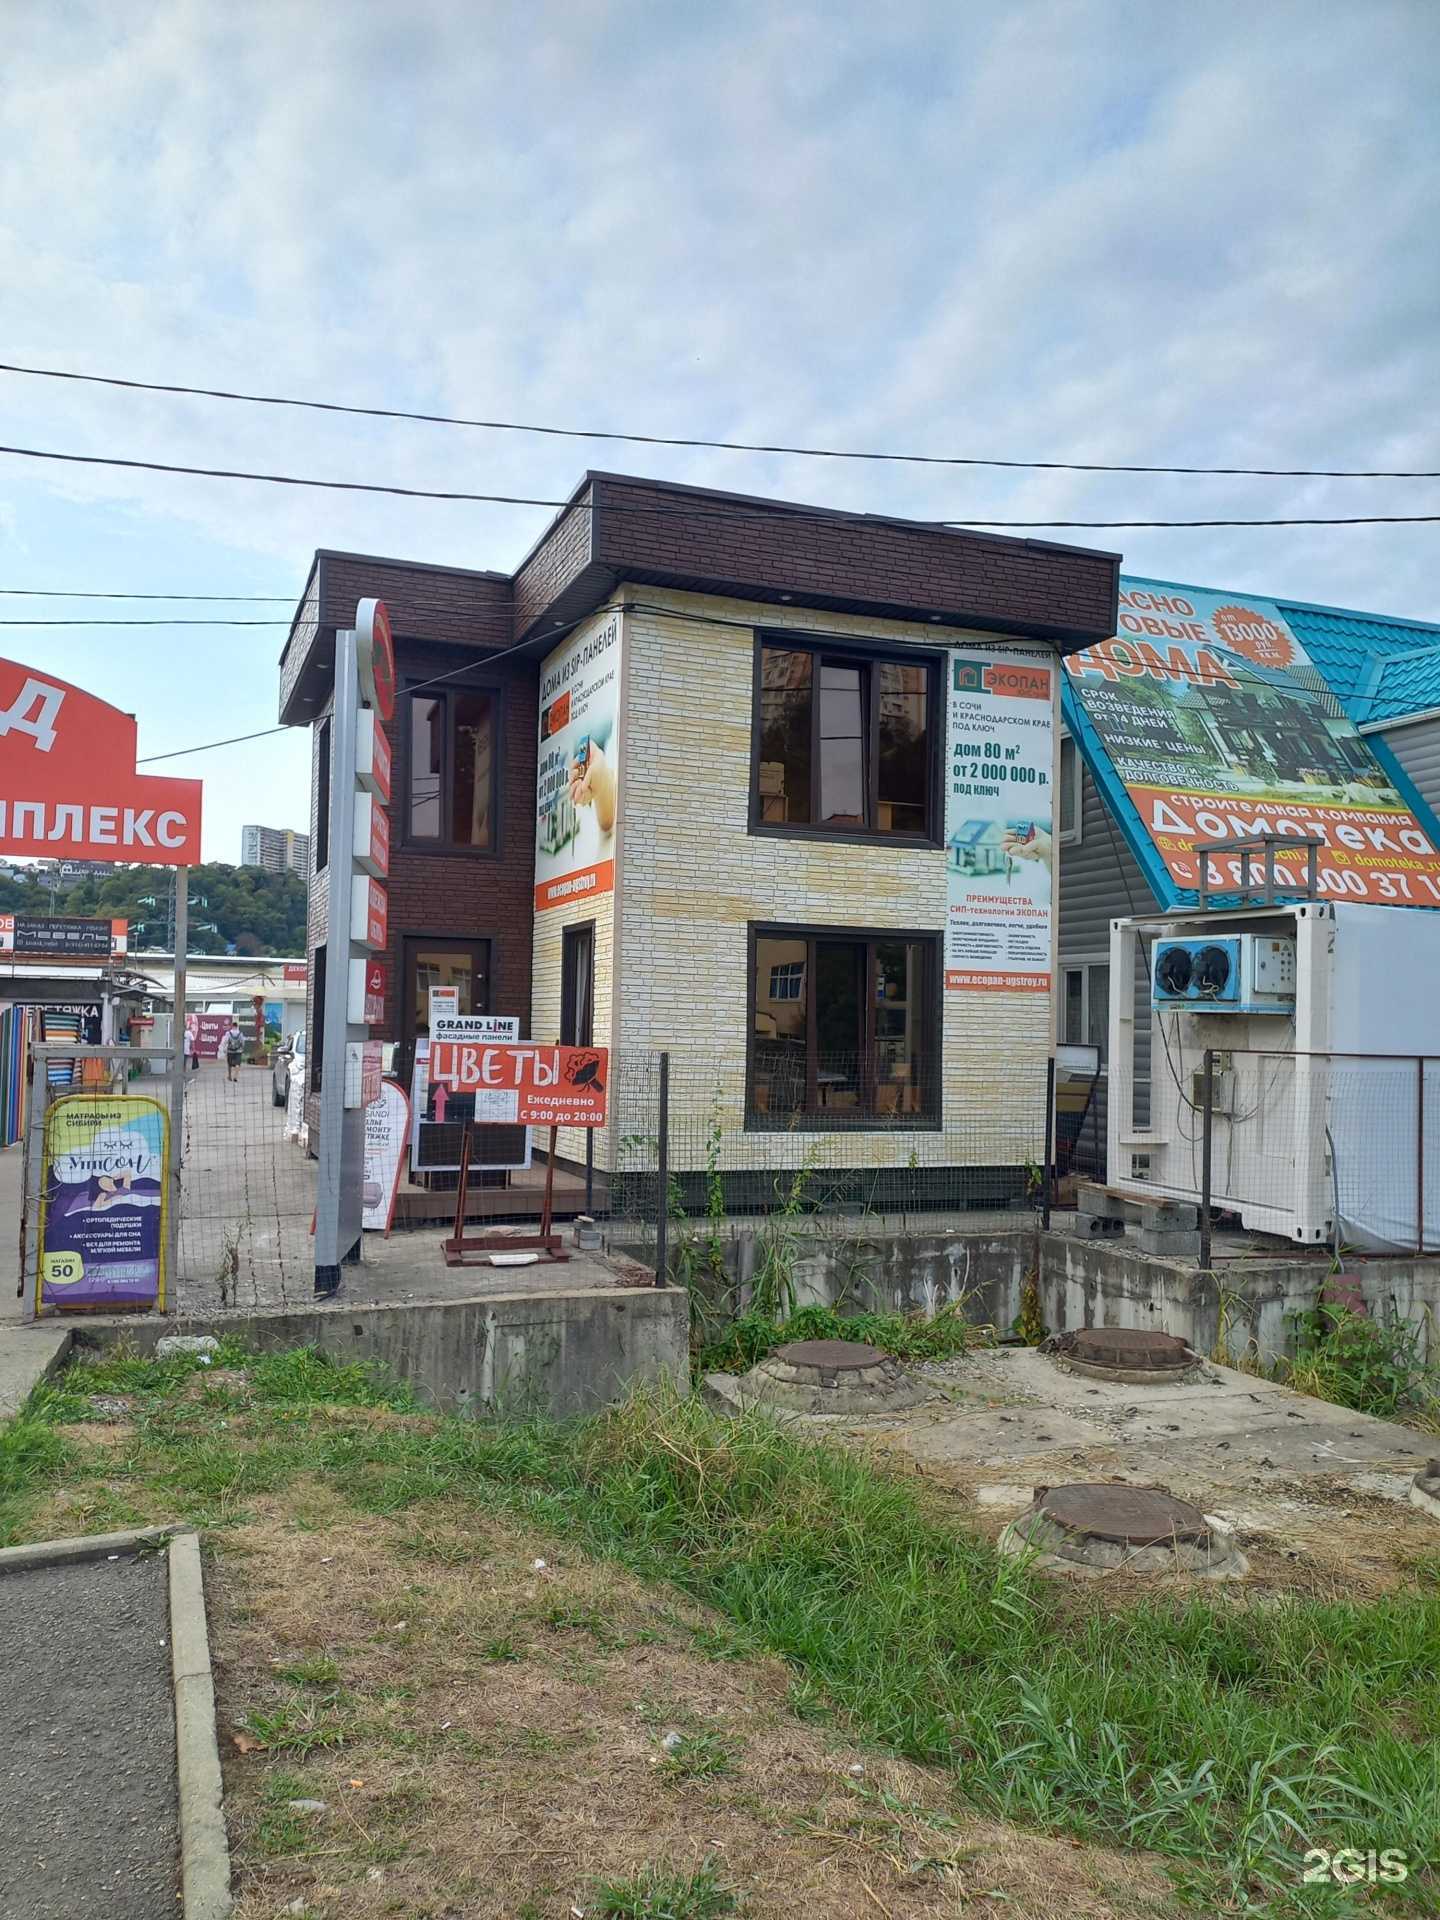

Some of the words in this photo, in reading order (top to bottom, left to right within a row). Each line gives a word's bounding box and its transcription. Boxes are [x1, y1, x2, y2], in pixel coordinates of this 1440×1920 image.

[1220, 622, 1278, 641] 13000
[541, 672, 561, 705] ДОМА
[562, 660, 570, 685] ИЗ
[570, 616, 617, 676] SIP-ПАНЕЛЕЙ
[1063, 637, 1242, 690] ДОМА
[987, 672, 1049, 690] ЭКОПАН
[1081, 688, 1118, 701] СРОК
[959, 702, 982, 711] СОЧИ
[1087, 700, 1177, 720] ВОЗВЕДЕНИЯ
[952, 711, 958, 719] И
[960, 713, 1031, 727] КРАСНОДАРСКОМ
[1032, 719, 1051, 729] КРАЕ
[952, 722, 970, 731] ПОД
[971, 723, 995, 733] КЛЮЧ
[1093, 712, 1109, 721] от
[1111, 713, 1128, 724] 14
[1132, 715, 1168, 729] ДНЕЙ
[953, 743, 981, 758] дом
[984, 742, 1001, 759] 80
[1104, 733, 1162, 750] НИЗКИЕ
[1165, 741, 1207, 755] ЦЕНЫ
[953, 764, 967, 777] от
[970, 762, 978, 778] 2
[981, 763, 1007, 781] 000
[1010, 765, 1036, 783] 000
[1038, 771, 1049, 786] р.
[1117, 757, 1186, 774] КАЧЕСТВО
[1125, 769, 1240, 792] ДОЛГОВЕЧНОСТЬ
[953, 782, 972, 796] под
[974, 785, 1000, 797] ключ
[1170, 795, 1313, 818] строительная
[1316, 809, 1413, 826] компания
[1151, 799, 1436, 855] Домотека
[1370, 871, 1412, 898] 37
[1417, 875, 1440, 900] 1
[966, 894, 1033, 905] ПРЕИМУЩЕСТВА
[950, 905, 1015, 916] СИП-технологии
[1017, 909, 1048, 917] ЭКОПАН
[436, 1019, 483, 1030] GRAND
[436, 1033, 480, 1041] фасадные
[433, 1045, 559, 1092] ЦВЕТЫ
[527, 1095, 594, 1106] Ежедневно
[66, 1112, 109, 1120] МАТРАСЫ
[530, 1111, 554, 1120] 9:00
[556, 1112, 571, 1122] до
[574, 1112, 603, 1122] 20:00
[51, 1264, 73, 1277] 50
